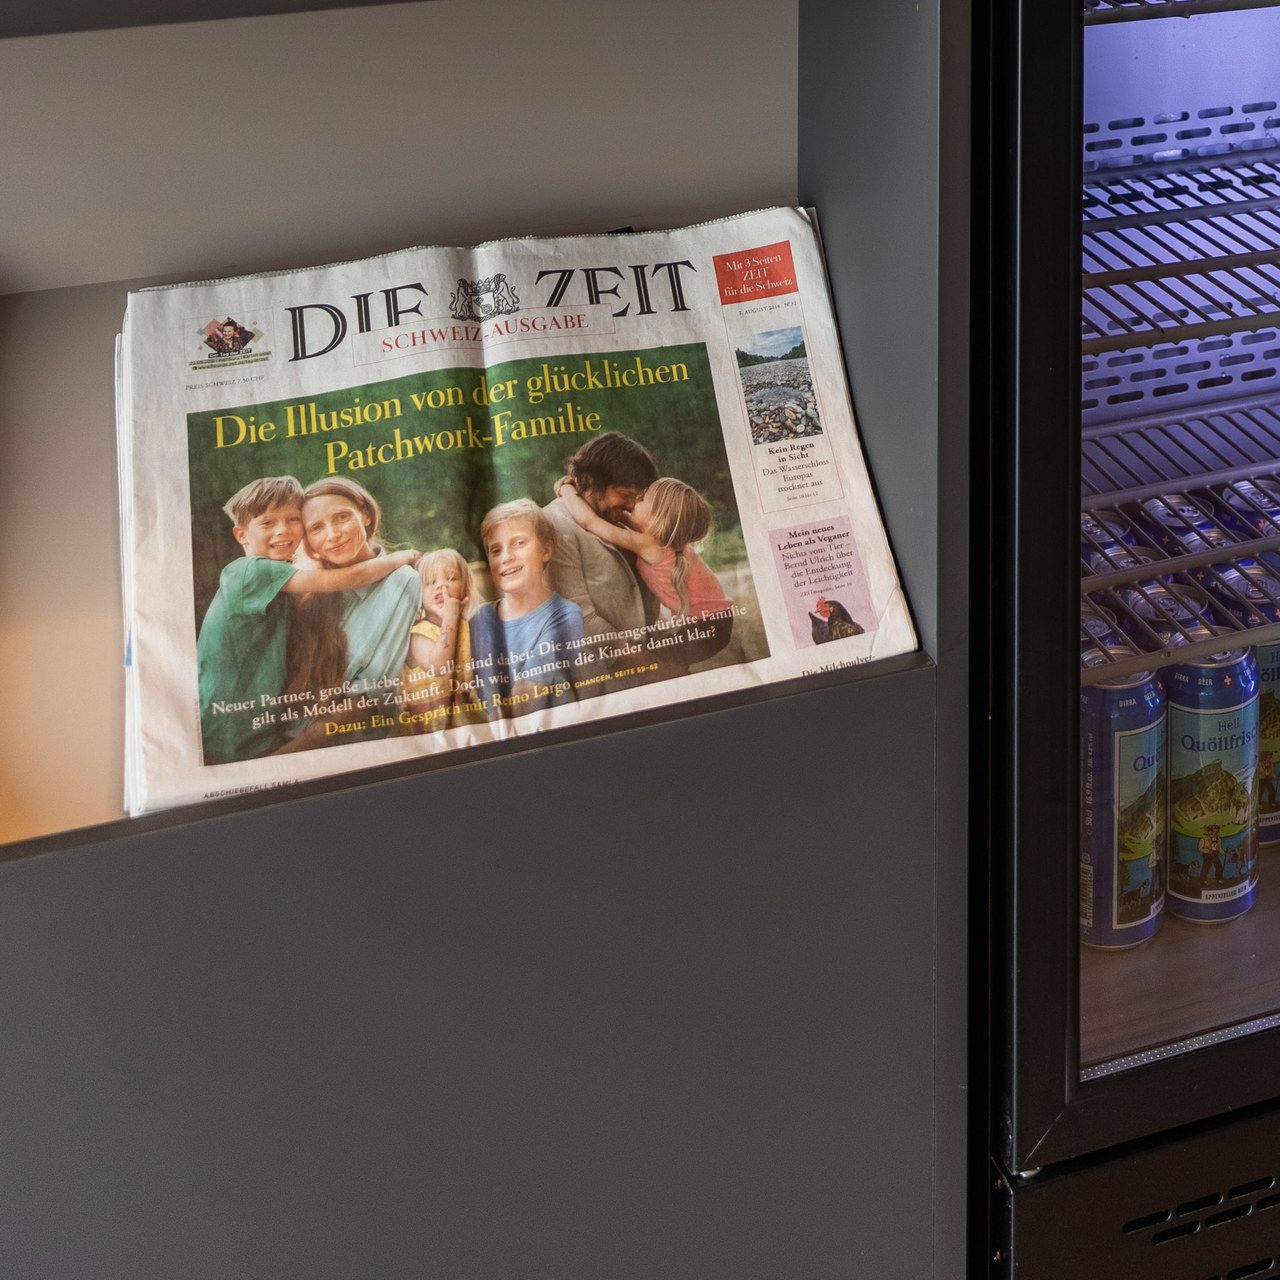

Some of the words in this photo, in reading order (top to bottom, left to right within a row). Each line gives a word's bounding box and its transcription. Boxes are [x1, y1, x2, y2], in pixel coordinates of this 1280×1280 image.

[724, 284, 739, 296] für
[740, 282, 753, 294] die
[754, 276, 793, 291] Schweiz
[726, 261, 743, 272] Mit
[752, 254, 781, 267] Seiten
[742, 267, 768, 280] ZEIT
[285, 282, 428, 362] DIE
[535, 260, 697, 317] ZEIT
[382, 313, 589, 353] SCHWEIZ-AUSGABE
[213, 414, 276, 449] Die
[285, 397, 402, 438] Illusion
[410, 386, 464, 412] von
[473, 375, 518, 406] der
[527, 357, 690, 404] glücklichen
[324, 402, 602, 475] Patchwork-Familie
[212, 699, 255, 715] Neuer
[260, 691, 315, 708] Partner,
[320, 681, 358, 700] große
[363, 675, 403, 691] Liebe,
[409, 664, 435, 682] und
[440, 660, 461, 674] alle
[465, 656, 493, 671] sind
[497, 645, 533, 666] dabei:
[539, 640, 561, 656] Die
[566, 613, 698, 650] zusammengewürfelte
[701, 604, 747, 622] Familie
[252, 712, 275, 730] gilt
[280, 708, 299, 721] als
[303, 697, 352, 719] Modell
[357, 695, 379, 709] der
[384, 683, 444, 705] Zukunft.
[449, 675, 484, 692] Doch
[489, 671, 509, 685] wie
[513, 658, 570, 682] kommen
[574, 650, 595, 666] die
[599, 641, 643, 659] Kinder
[646, 633, 685, 650] damit
[687, 625, 716, 642] klar?
[1218, 718, 1240, 732] Hell
